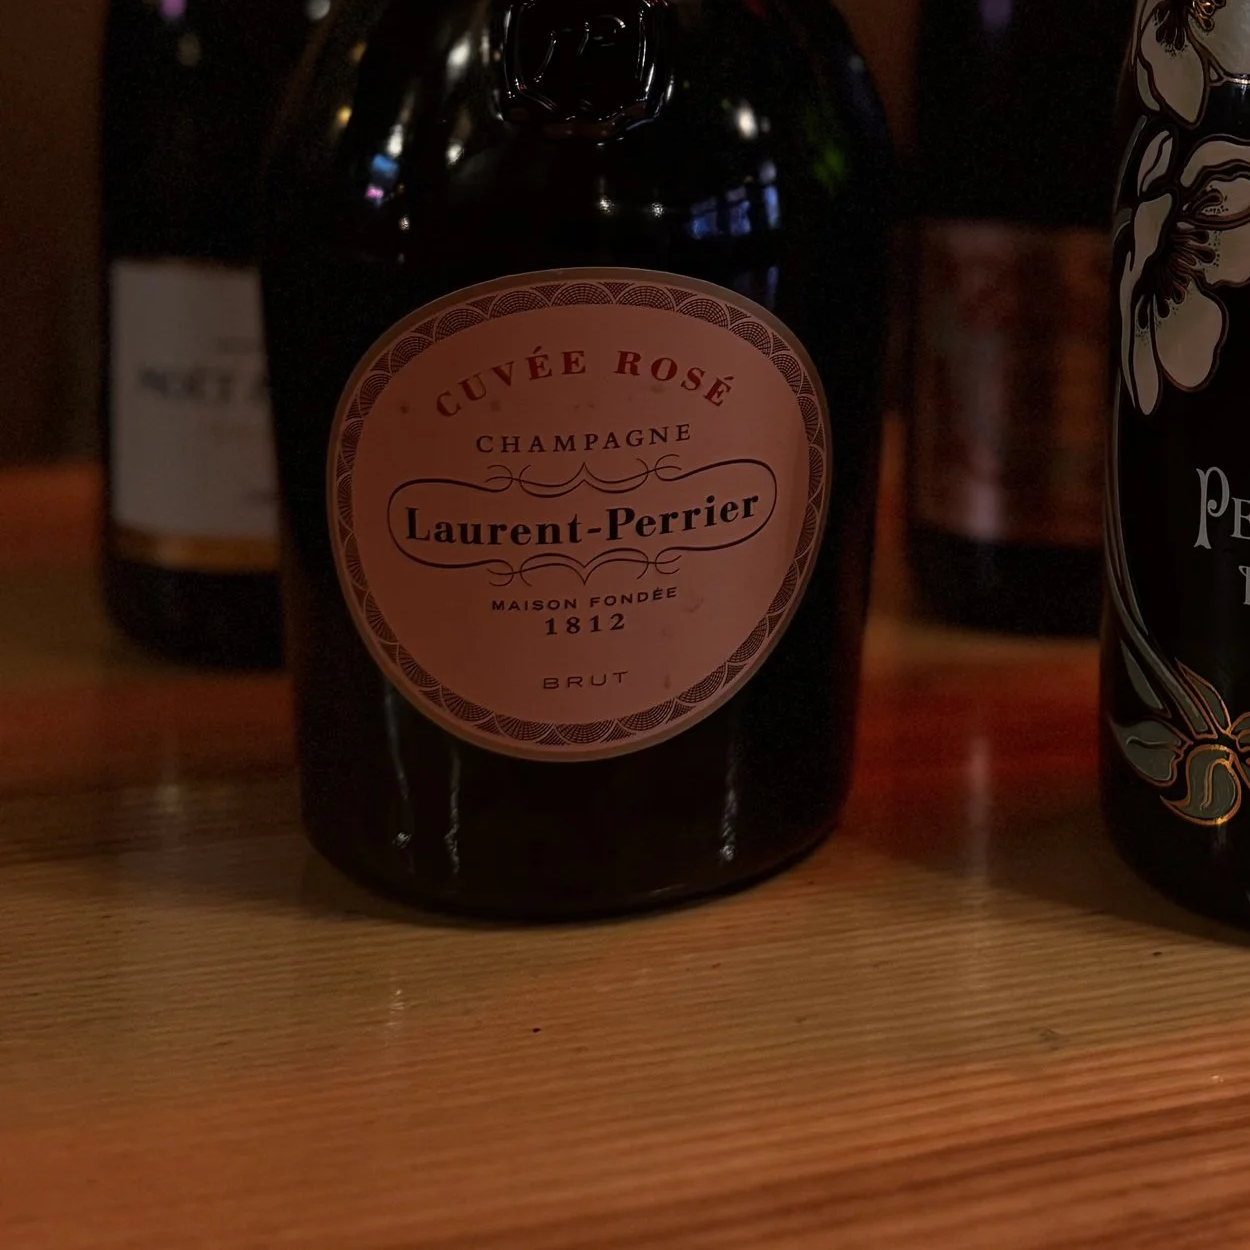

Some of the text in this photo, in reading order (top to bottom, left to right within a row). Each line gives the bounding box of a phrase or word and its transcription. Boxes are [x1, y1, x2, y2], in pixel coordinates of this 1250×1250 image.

[436, 346, 735, 418] CUVÉE ROSÉ
[475, 423, 692, 454] CHAMPAGNE
[405, 493, 760, 547] Laurent-Perrier
[491, 586, 679, 612] MAISON FONDÉE
[544, 612, 626, 636] 1812
[542, 671, 629, 690] BRUT
